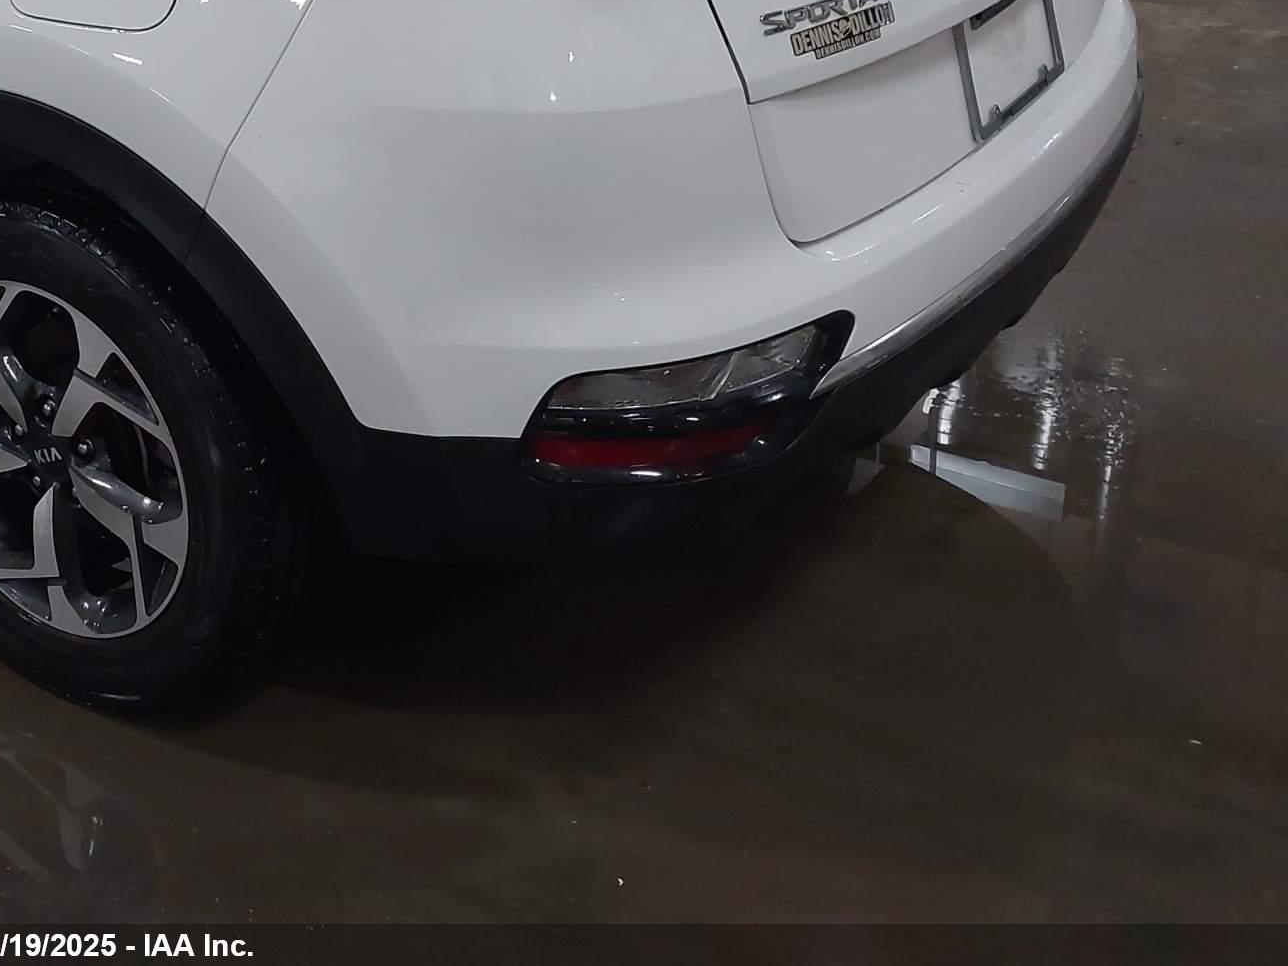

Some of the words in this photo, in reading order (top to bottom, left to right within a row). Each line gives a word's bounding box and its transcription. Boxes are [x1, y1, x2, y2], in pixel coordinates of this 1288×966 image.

[791, 19, 843, 55] DENNIS
[848, 1, 894, 36] DILLON
[33, 447, 62, 464] KIA
